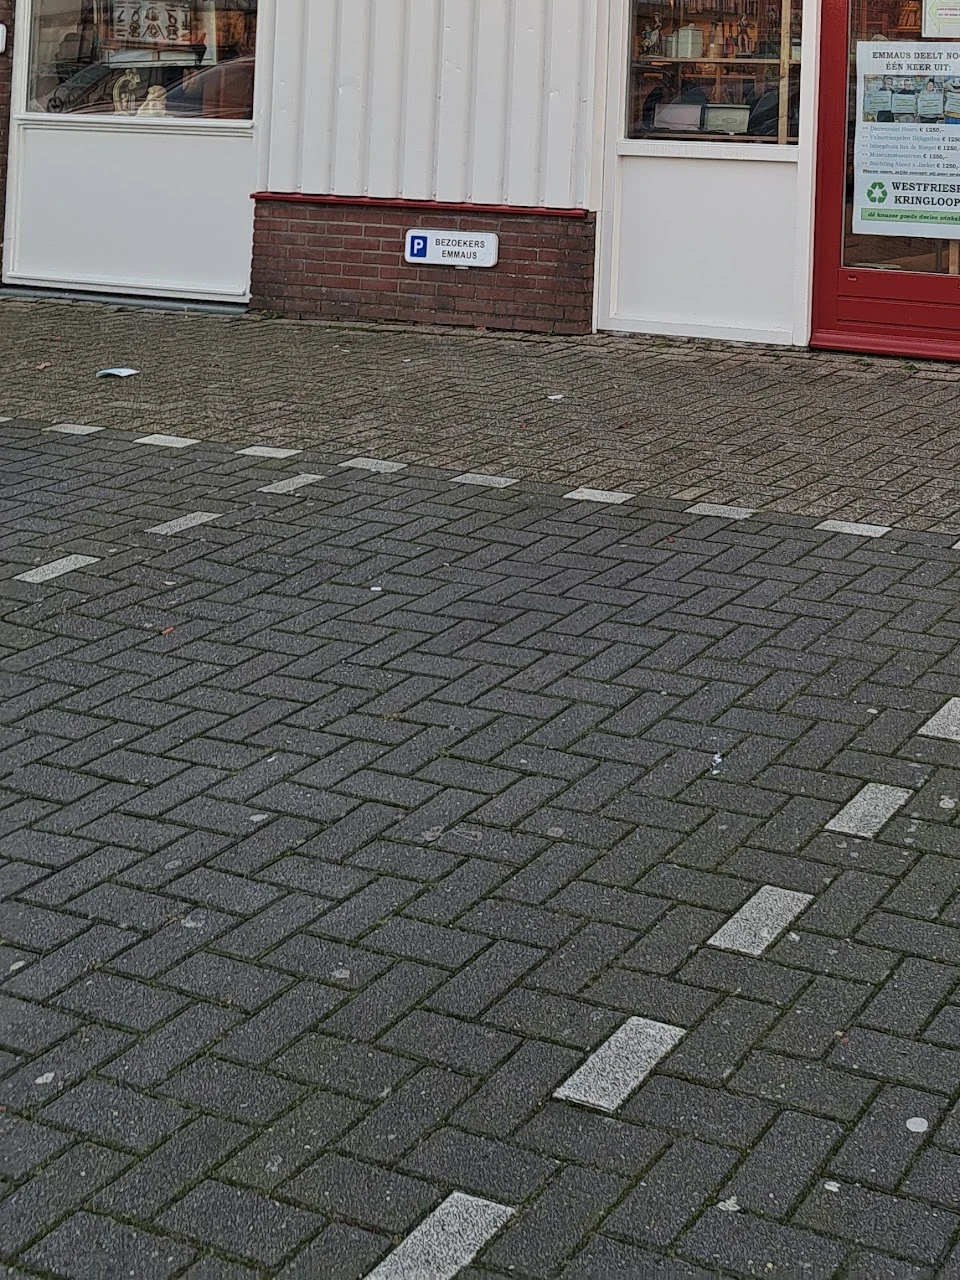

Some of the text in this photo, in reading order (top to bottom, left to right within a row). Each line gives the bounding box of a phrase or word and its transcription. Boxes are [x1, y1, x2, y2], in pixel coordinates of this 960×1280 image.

[886, 61, 903, 70] ÉÉN
[894, 195, 960, 207] KRINGLOOP
[413, 238, 486, 254] P BEZOEKERS
[441, 250, 477, 259] EMMAUS
